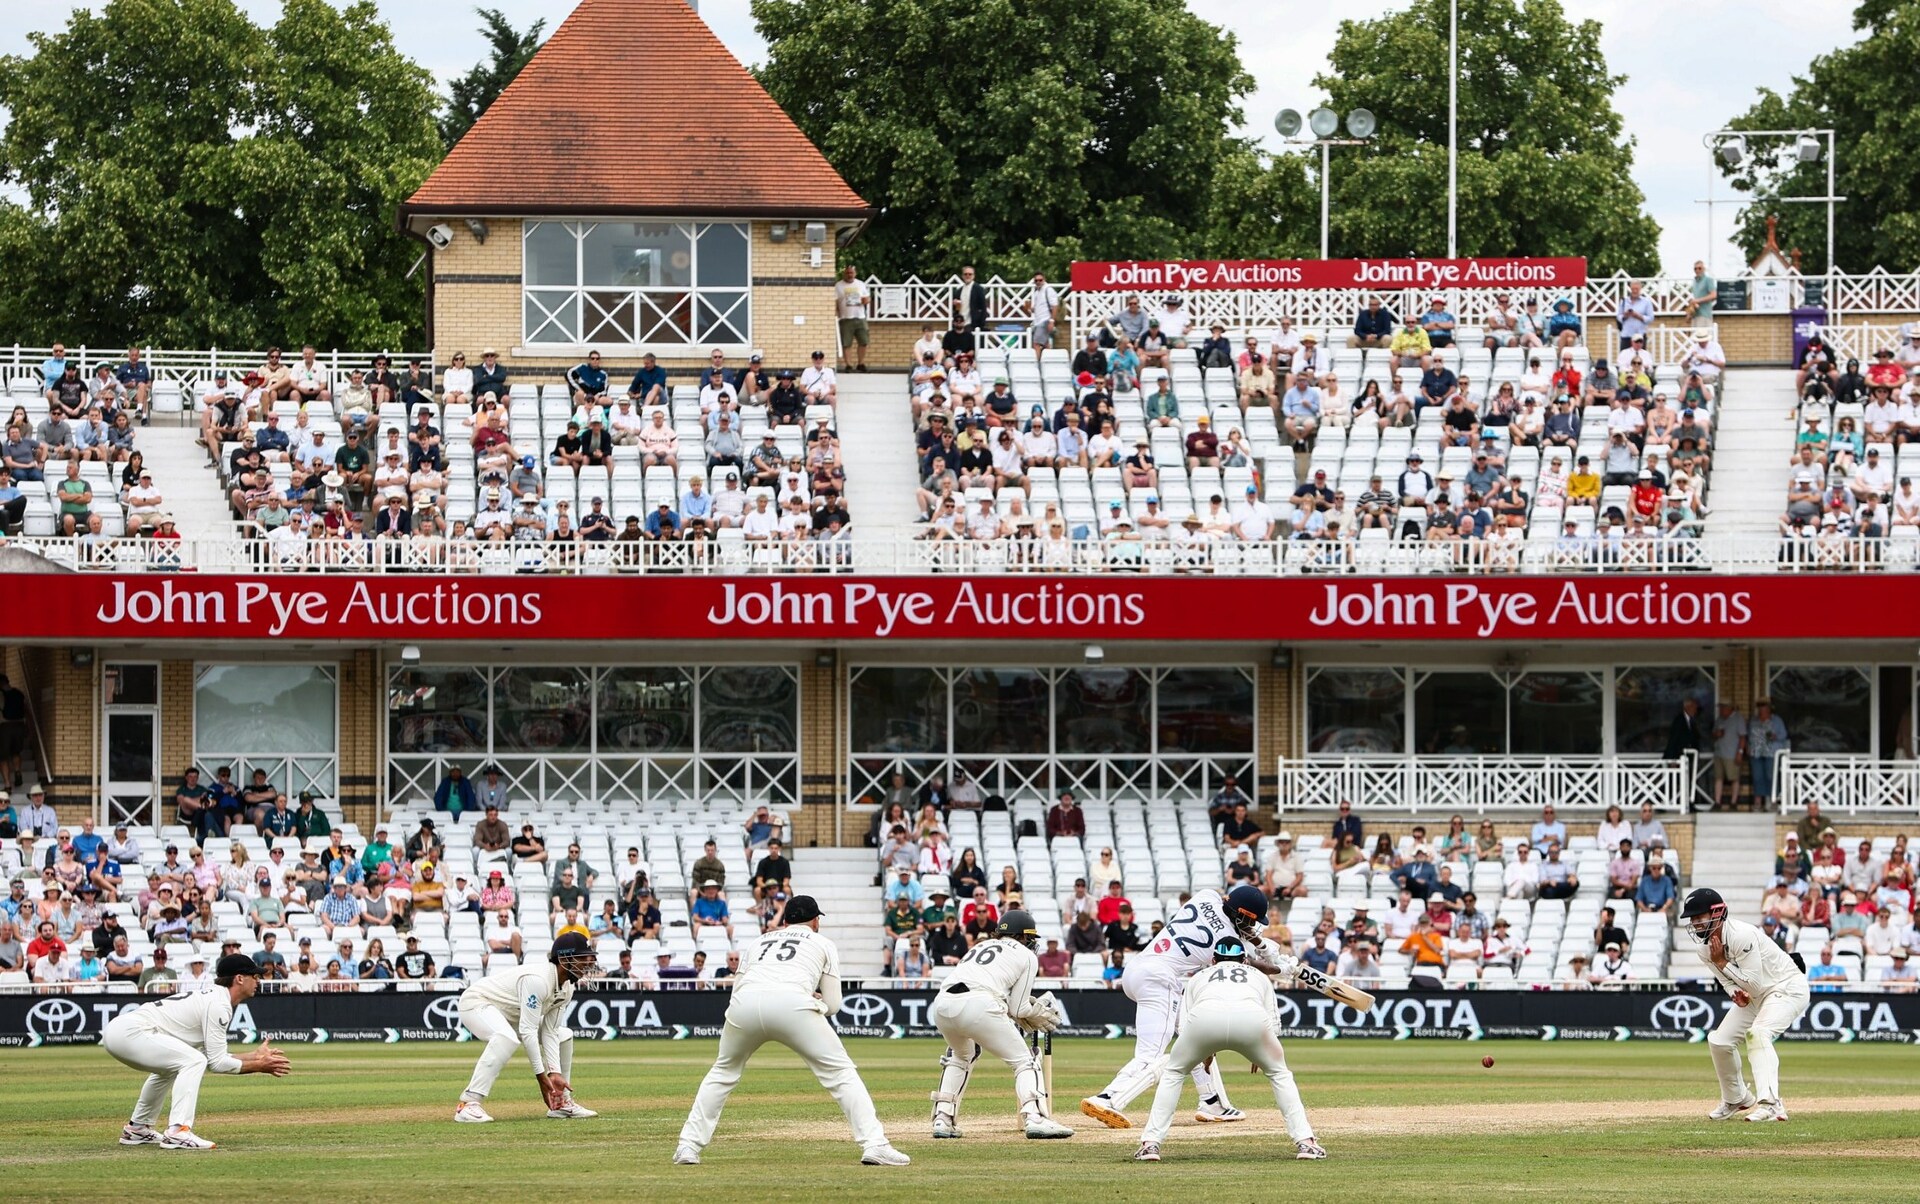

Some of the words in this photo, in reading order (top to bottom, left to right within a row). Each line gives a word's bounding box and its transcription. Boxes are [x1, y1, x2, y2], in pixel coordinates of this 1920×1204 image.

[1103, 264, 1162, 284] John
[1164, 264, 1208, 289] Pye
[1212, 263, 1302, 282] Auctions
[1353, 261, 1412, 282] John
[1416, 261, 1460, 286] Pye
[1464, 261, 1556, 281] Auctions
[97, 580, 225, 624] John
[236, 582, 328, 636] Pye
[338, 581, 542, 625] Auctions
[707, 582, 833, 625] John
[843, 583, 934, 637] Pye
[945, 581, 1145, 626] Auctions
[1310, 583, 1435, 626] John
[1446, 584, 1537, 637] Pye
[1548, 581, 1752, 625] Auctions
[1199, 901, 1225, 933] ARCHER
[1166, 903, 1214, 957] 22
[758, 939, 801, 962] 75
[1208, 967, 1248, 983] 48
[1298, 968, 1327, 989] DSC
[1307, 998, 1481, 1029] TOYOTA
[260, 1031, 310, 1042] Rothesay
[402, 1029, 452, 1041] Rothesay
[836, 1025, 886, 1037] Rothesay
[1279, 1028, 1320, 1039] othesay
[1414, 1027, 1464, 1040] Rothesay
[1560, 1028, 1611, 1040] Rothesay
[1859, 1031, 1911, 1043] Rothesay
